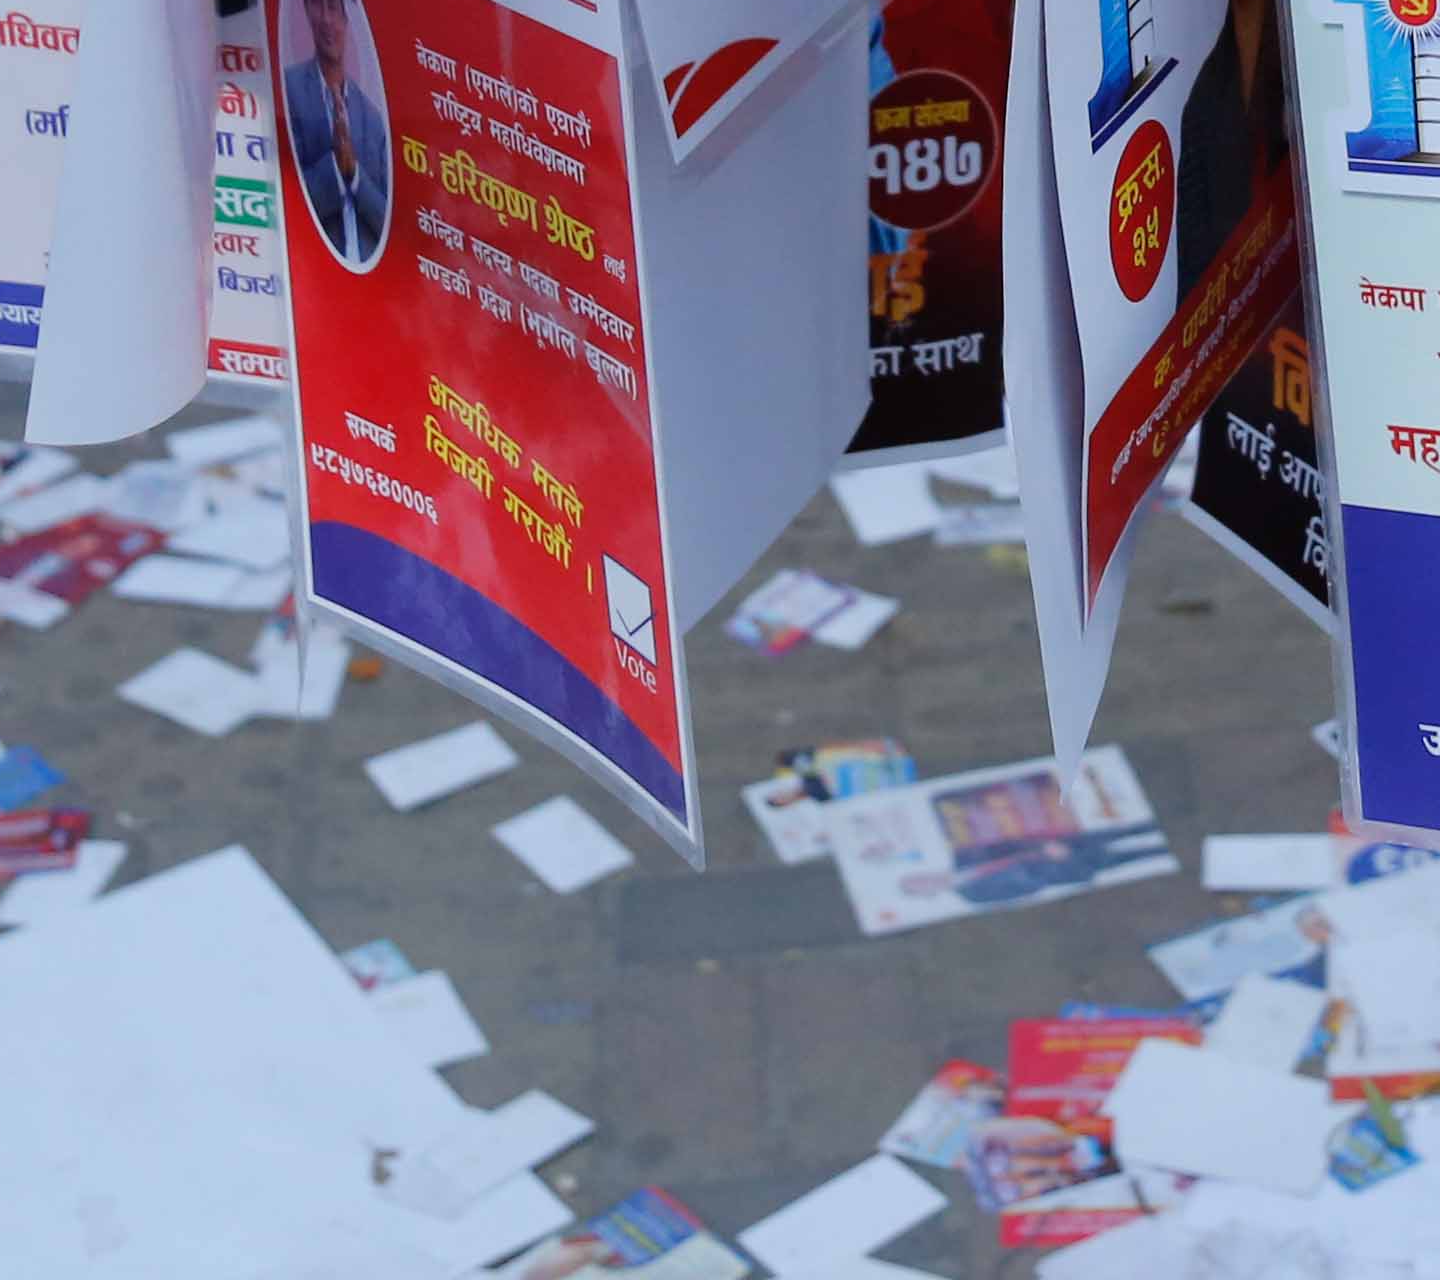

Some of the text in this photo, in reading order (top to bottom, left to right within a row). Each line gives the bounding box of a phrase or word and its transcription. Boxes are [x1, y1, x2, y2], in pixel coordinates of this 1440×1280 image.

[416, 38, 456, 81] नेकपा
[431, 91, 586, 187] राष्ट्रिय महाधिवेशनमा
[868, 136, 981, 196] १४७
[401, 135, 627, 285] क. हरिकृष्ण श्रेष्ठ लाई
[416, 255, 471, 301] गण्डकी
[477, 281, 513, 323] प्रदेश
[471, 236, 513, 277] सदस्य
[518, 261, 561, 303] पदका
[566, 287, 636, 352] उम्मेदवार
[1359, 277, 1425, 312] नेकपा
[911, 333, 984, 376] साथ
[344, 410, 397, 454] सम्पर्क
[1227, 411, 1276, 480] लाई
[311, 441, 440, 526] ९८५७६४०००६
[424, 414, 496, 500] विजयी
[504, 486, 574, 570] गराऔं
[531, 458, 584, 529] मतले
[613, 638, 658, 694] Vote
